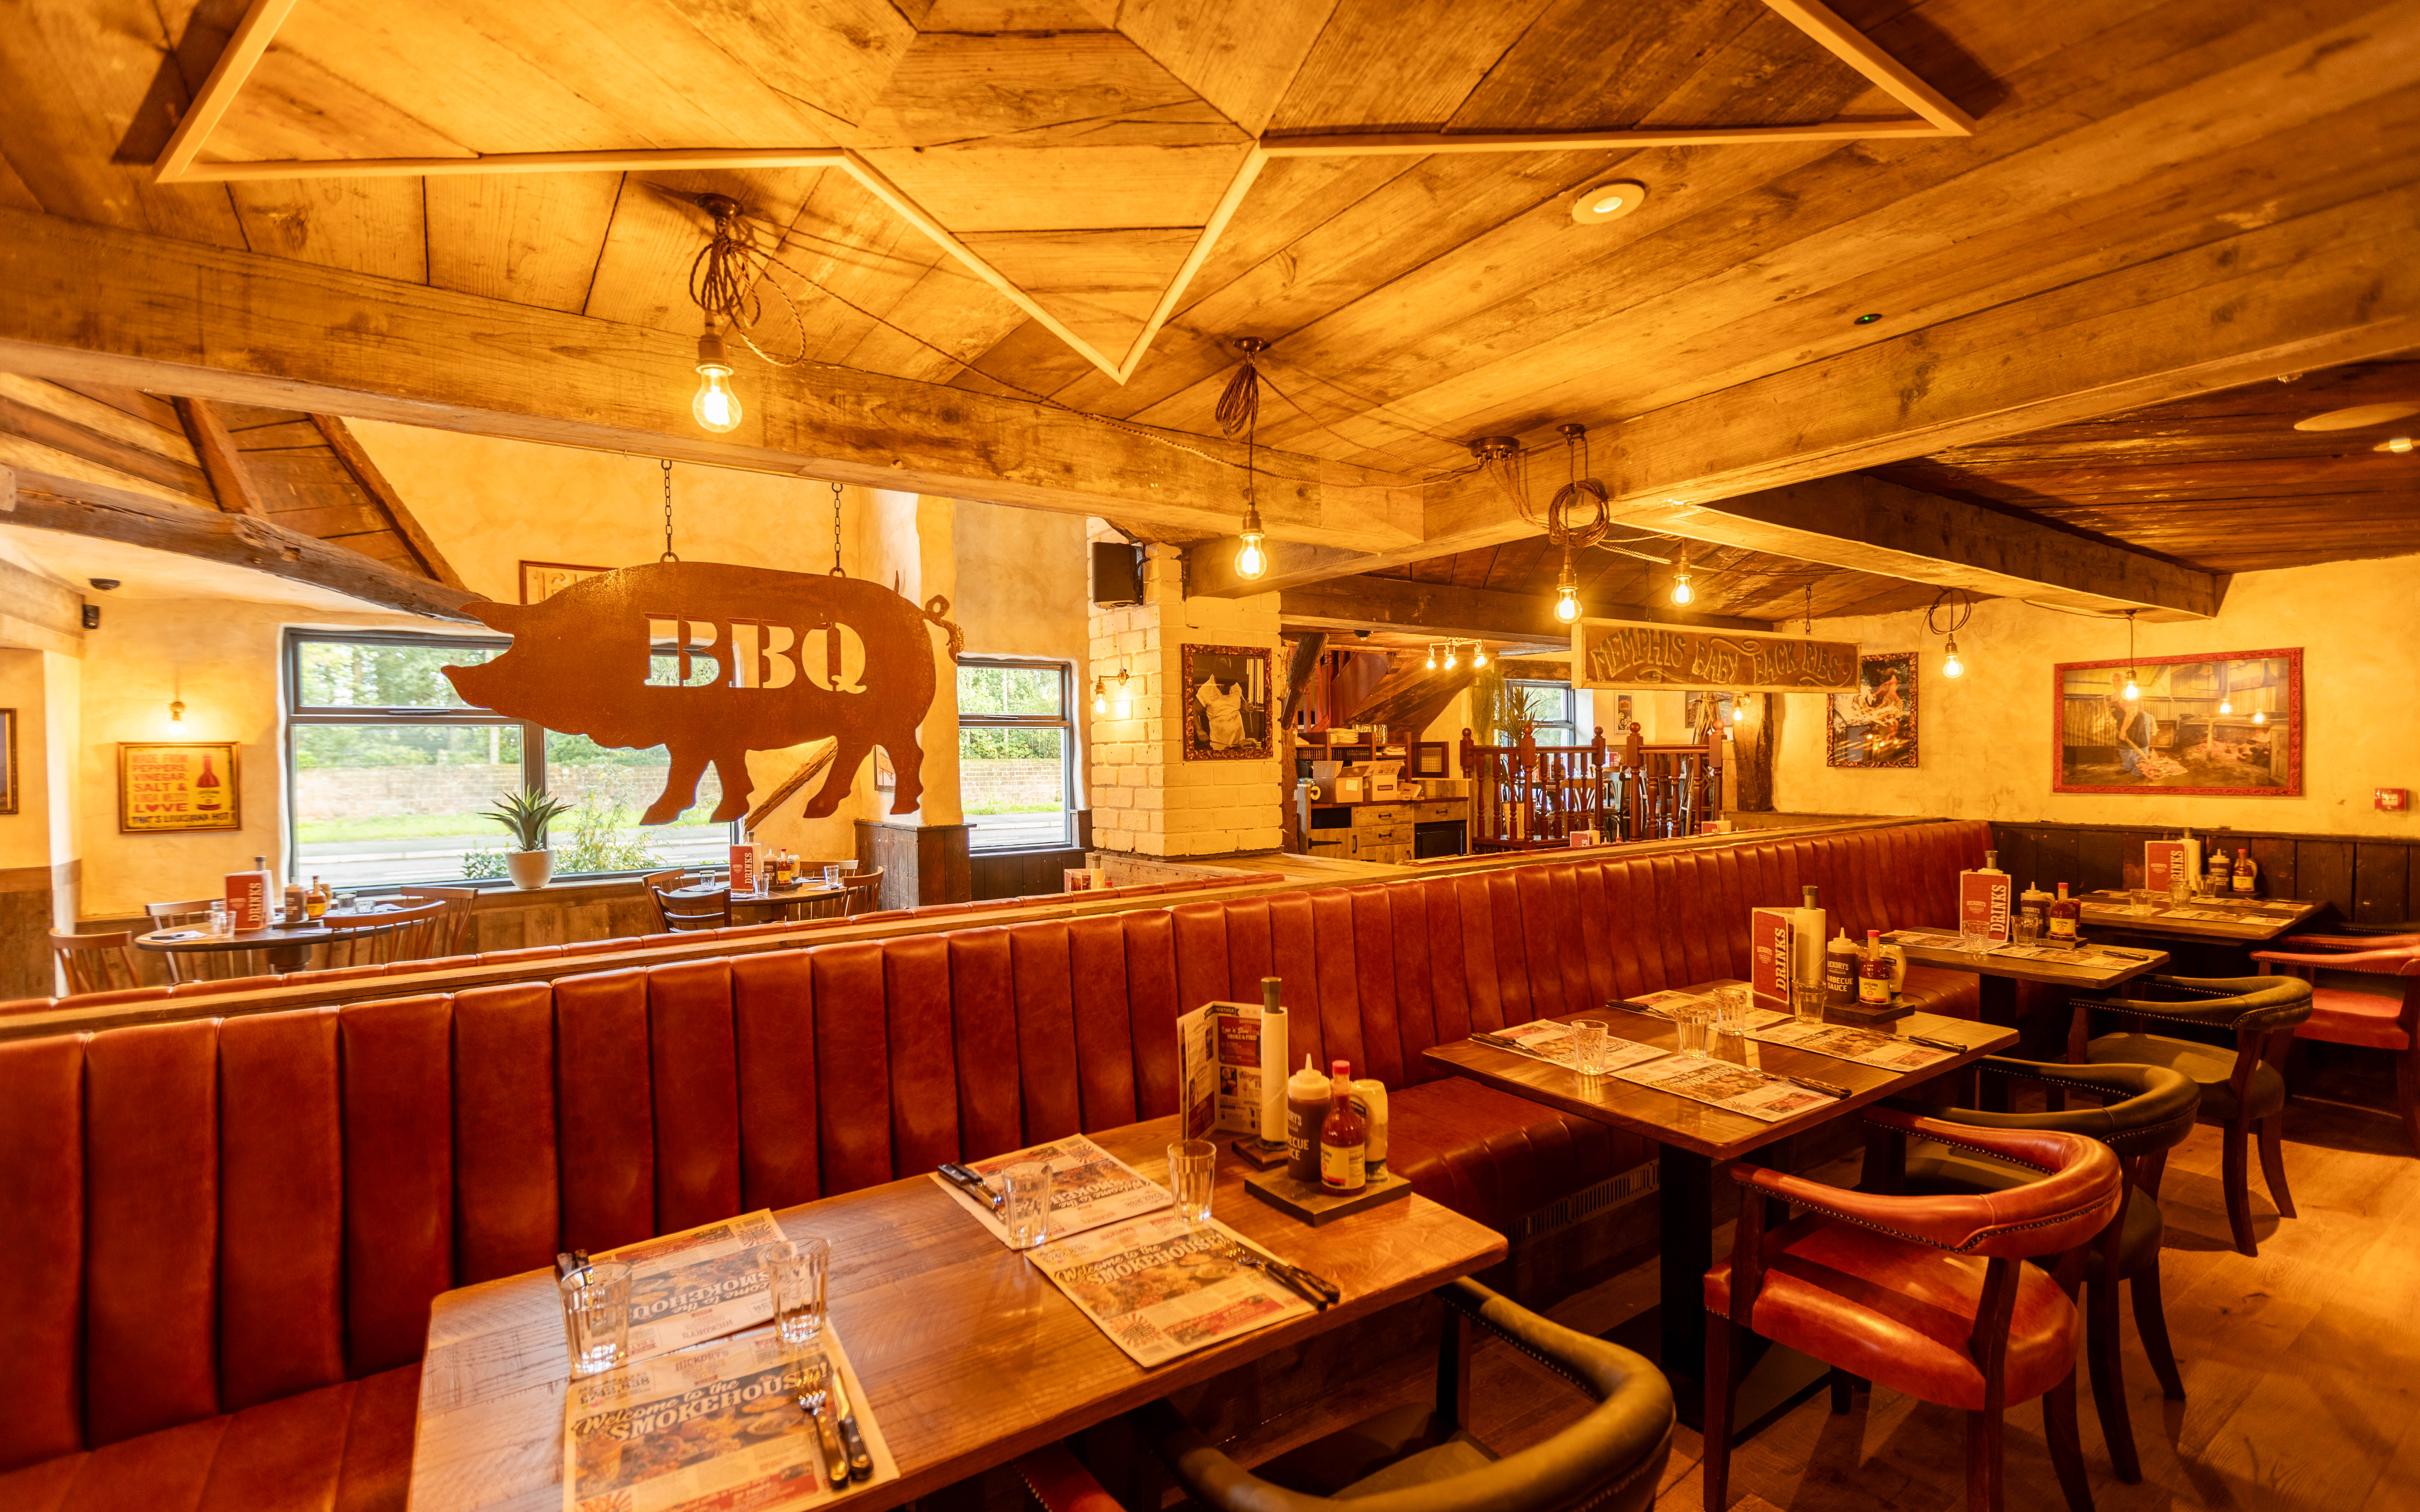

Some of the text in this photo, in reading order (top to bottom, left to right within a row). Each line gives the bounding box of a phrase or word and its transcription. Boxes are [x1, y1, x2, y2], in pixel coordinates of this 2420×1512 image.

[644, 613, 867, 694] BBQ
[1590, 628, 1838, 685] MEMPHIS BABY BACK RIBS
[134, 783, 189, 792] SALT &
[131, 815, 162, 824] THAT'S
[163, 813, 209, 822] LOUISIANA
[248, 883, 262, 922] DRINKS
[1990, 885, 2007, 933] DRINKS
[1775, 927, 1787, 992] DRINKS
[1827, 975, 1853, 985] ARBECUE
[1828, 982, 1848, 992] SAUCE
[1054, 1243, 1162, 1282] Welcome to the
[671, 1302, 699, 1314] the
[702, 1296, 721, 1305] to
[571, 1379, 740, 1435] Welcome to the
